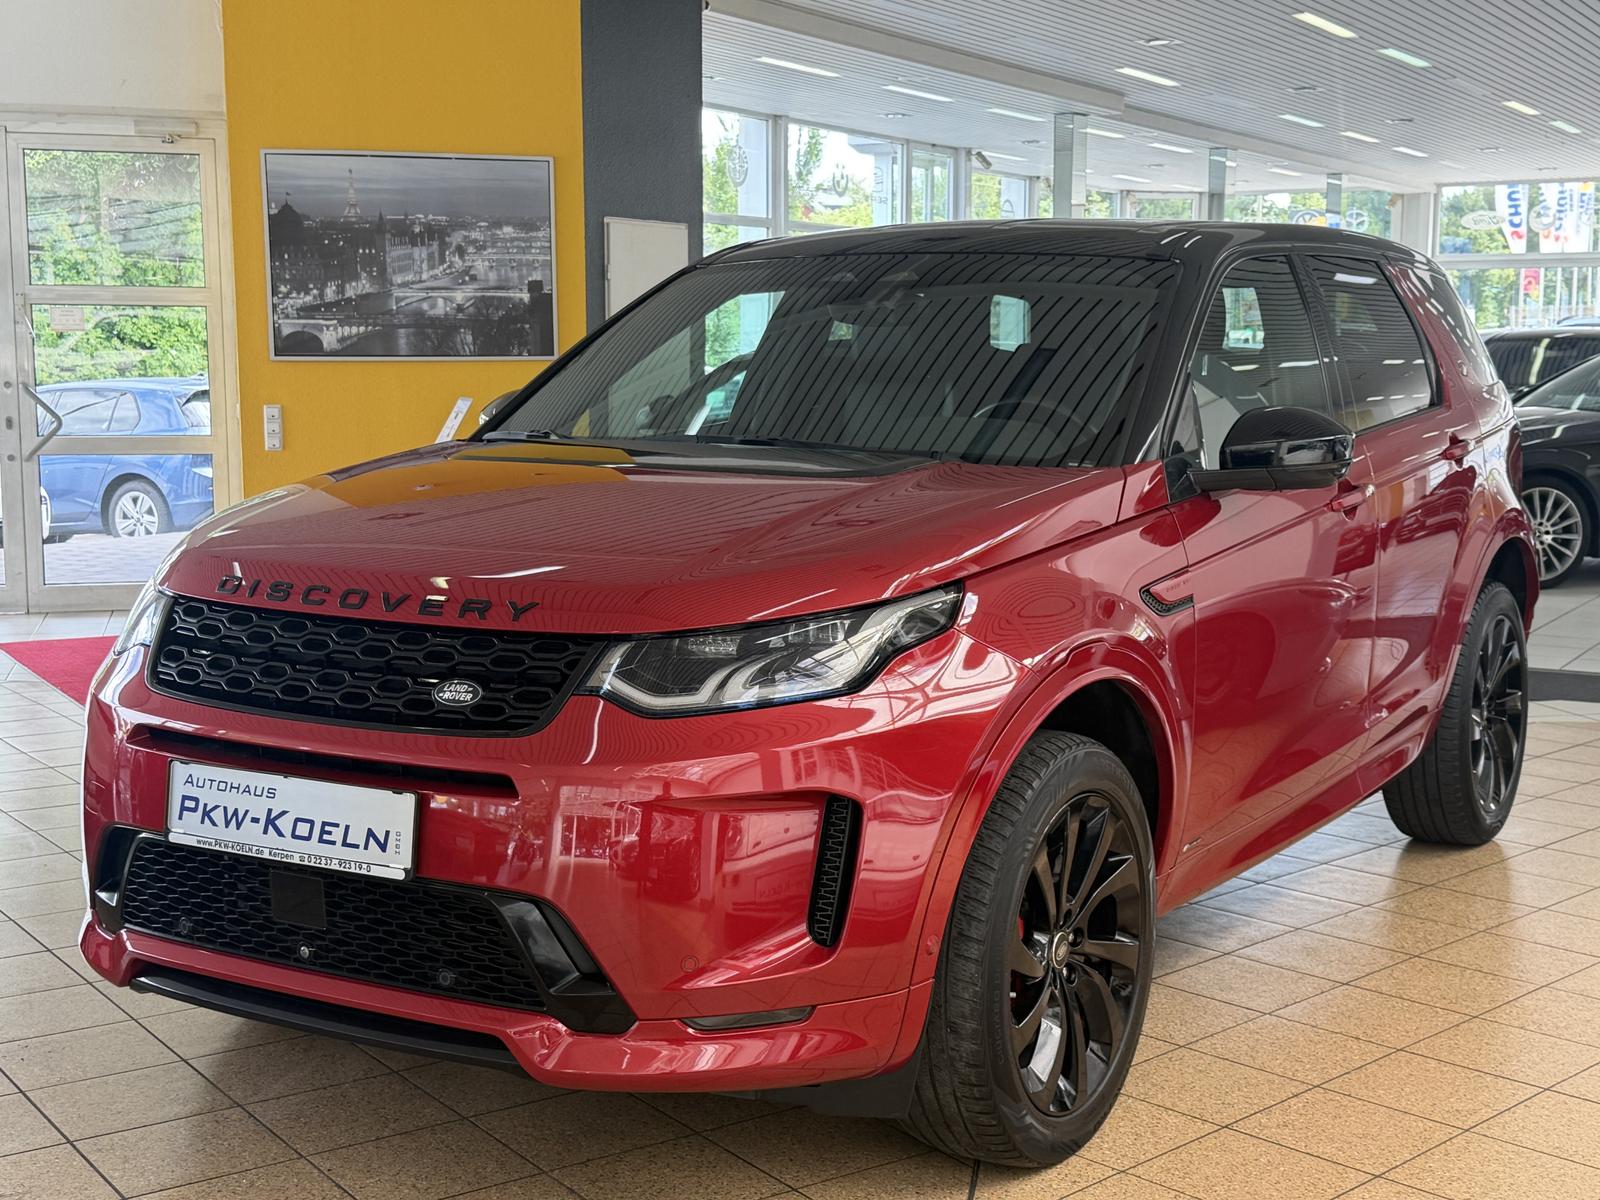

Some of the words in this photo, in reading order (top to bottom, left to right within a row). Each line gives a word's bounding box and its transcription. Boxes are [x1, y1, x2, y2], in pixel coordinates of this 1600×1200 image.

[215, 575, 540, 622] DISCOVERY
[442, 691, 473, 701] ROVER
[443, 683, 468, 692] LAND
[183, 773, 277, 799] AUTOHAUS
[177, 794, 391, 854] PKW-KOELN
[268, 847, 295, 862] Kerpen
